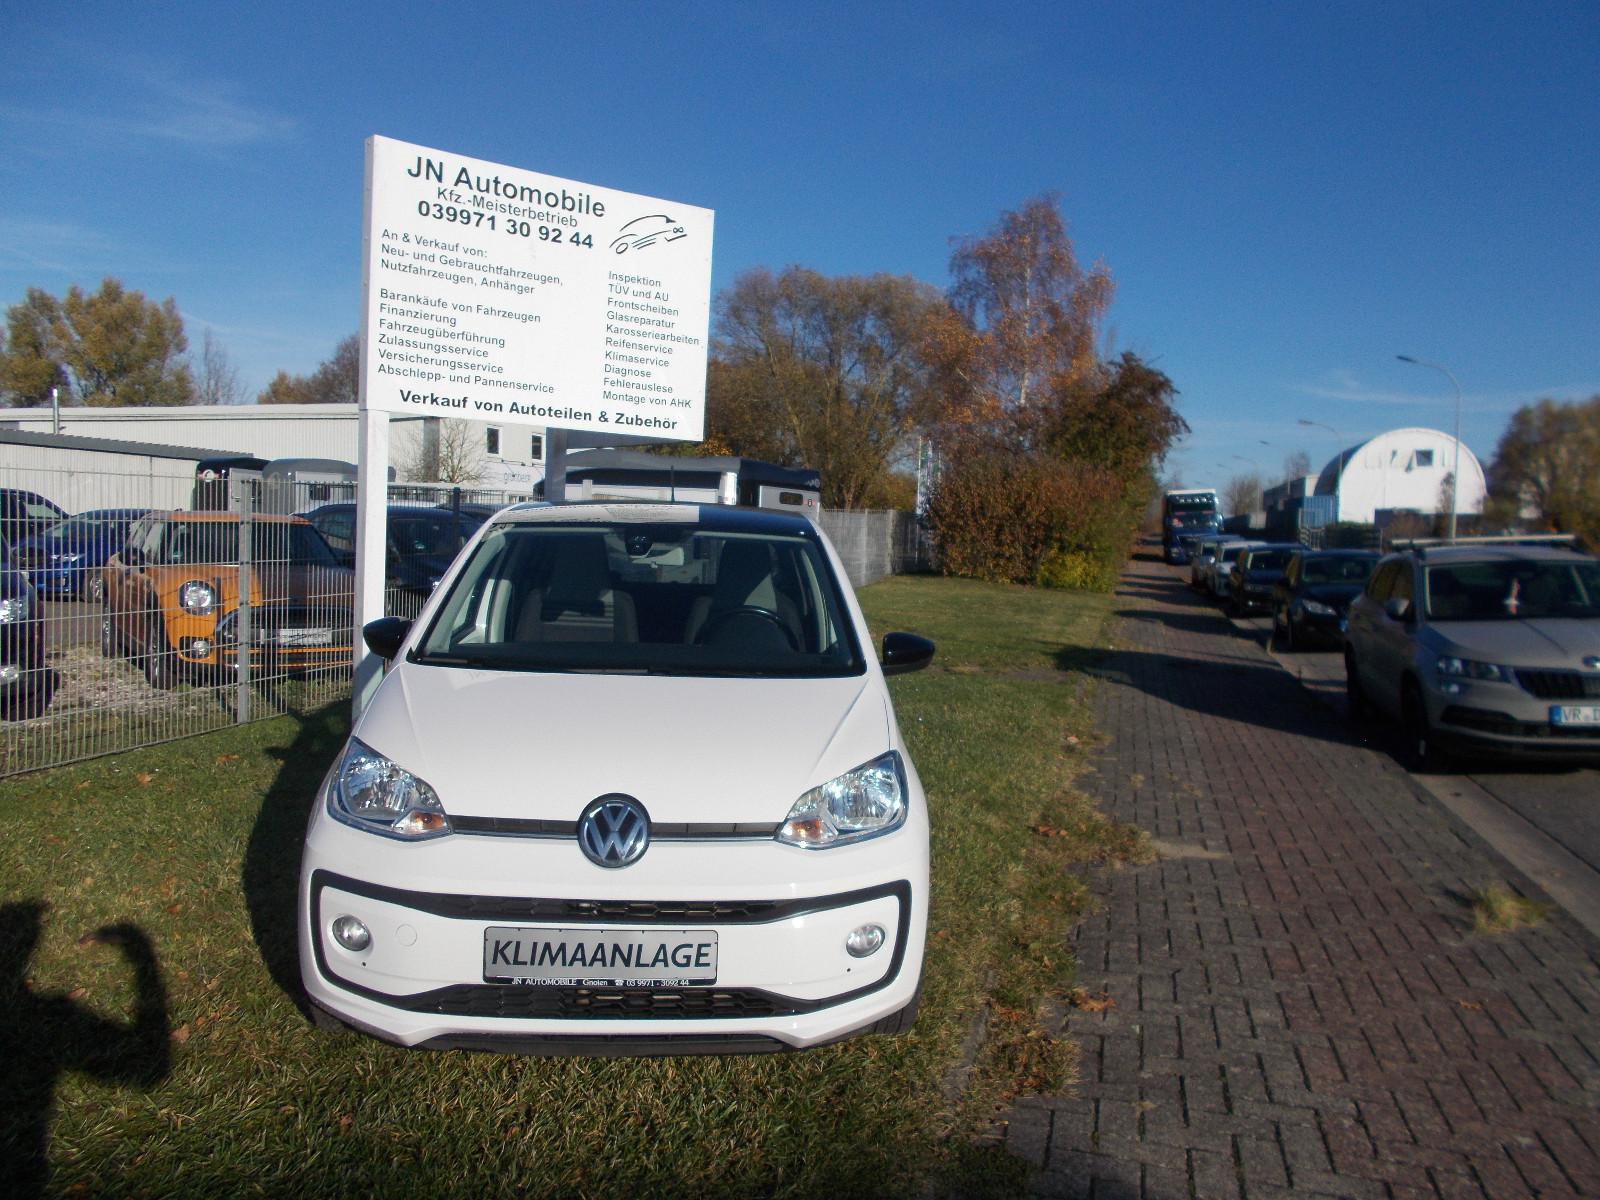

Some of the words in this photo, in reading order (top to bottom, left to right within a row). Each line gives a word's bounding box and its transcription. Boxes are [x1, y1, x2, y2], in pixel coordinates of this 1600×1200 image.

[408, 156, 443, 183] JN
[454, 167, 605, 217] Automobile
[437, 187, 577, 228] Kfz.-Meisterbetrieb
[418, 200, 496, 231] 039971
[506, 219, 531, 237] 30
[538, 226, 563, 243] 92
[570, 232, 593, 249] 44
[382, 229, 398, 240] An
[402, 233, 410, 242] &
[415, 235, 459, 252] Verkauf
[463, 246, 488, 258] von:
[381, 258, 477, 287] Nutzfahrzeugen,
[481, 277, 535, 295] Anhänger
[382, 243, 409, 257] Neu-
[413, 251, 435, 262] und
[440, 254, 563, 286] Gebrauchtfahrzeugen,
[608, 270, 661, 287] Inspektion
[608, 283, 629, 295] TÜV
[633, 289, 651, 299] und
[655, 291, 669, 301] AU
[380, 288, 448, 309] Barankäufe
[452, 302, 472, 313] von
[477, 305, 541, 323] Fahrzeugen
[380, 303, 457, 327] Finanzierung
[608, 297, 678, 317] Frontscheiben
[607, 310, 675, 328] Glasreparatur
[378, 333, 488, 358] Zulassungsservice
[379, 318, 505, 348] Fahrzeugüberführung
[606, 324, 699, 345] Karosseriearbeiten
[606, 337, 673, 354] Reifenservice
[378, 348, 503, 373] Versicherungsservice
[604, 364, 651, 377] Diagnose
[605, 350, 669, 367] Klimaservice
[378, 363, 446, 381] Abschlepp-
[449, 372, 470, 384] und
[474, 376, 554, 394] Pannenservice
[604, 377, 672, 393] Fehlerauslese
[400, 389, 468, 409] Verkauf
[474, 400, 503, 412] von
[509, 402, 592, 422] Autoteilen
[598, 411, 609, 423] &
[615, 413, 678, 430] Zubehör
[603, 390, 645, 405] Montage
[649, 397, 666, 406] von
[670, 398, 692, 408] AHK
[492, 940, 712, 968] KLIMAANLAGE
[512, 977, 521, 985] JN
